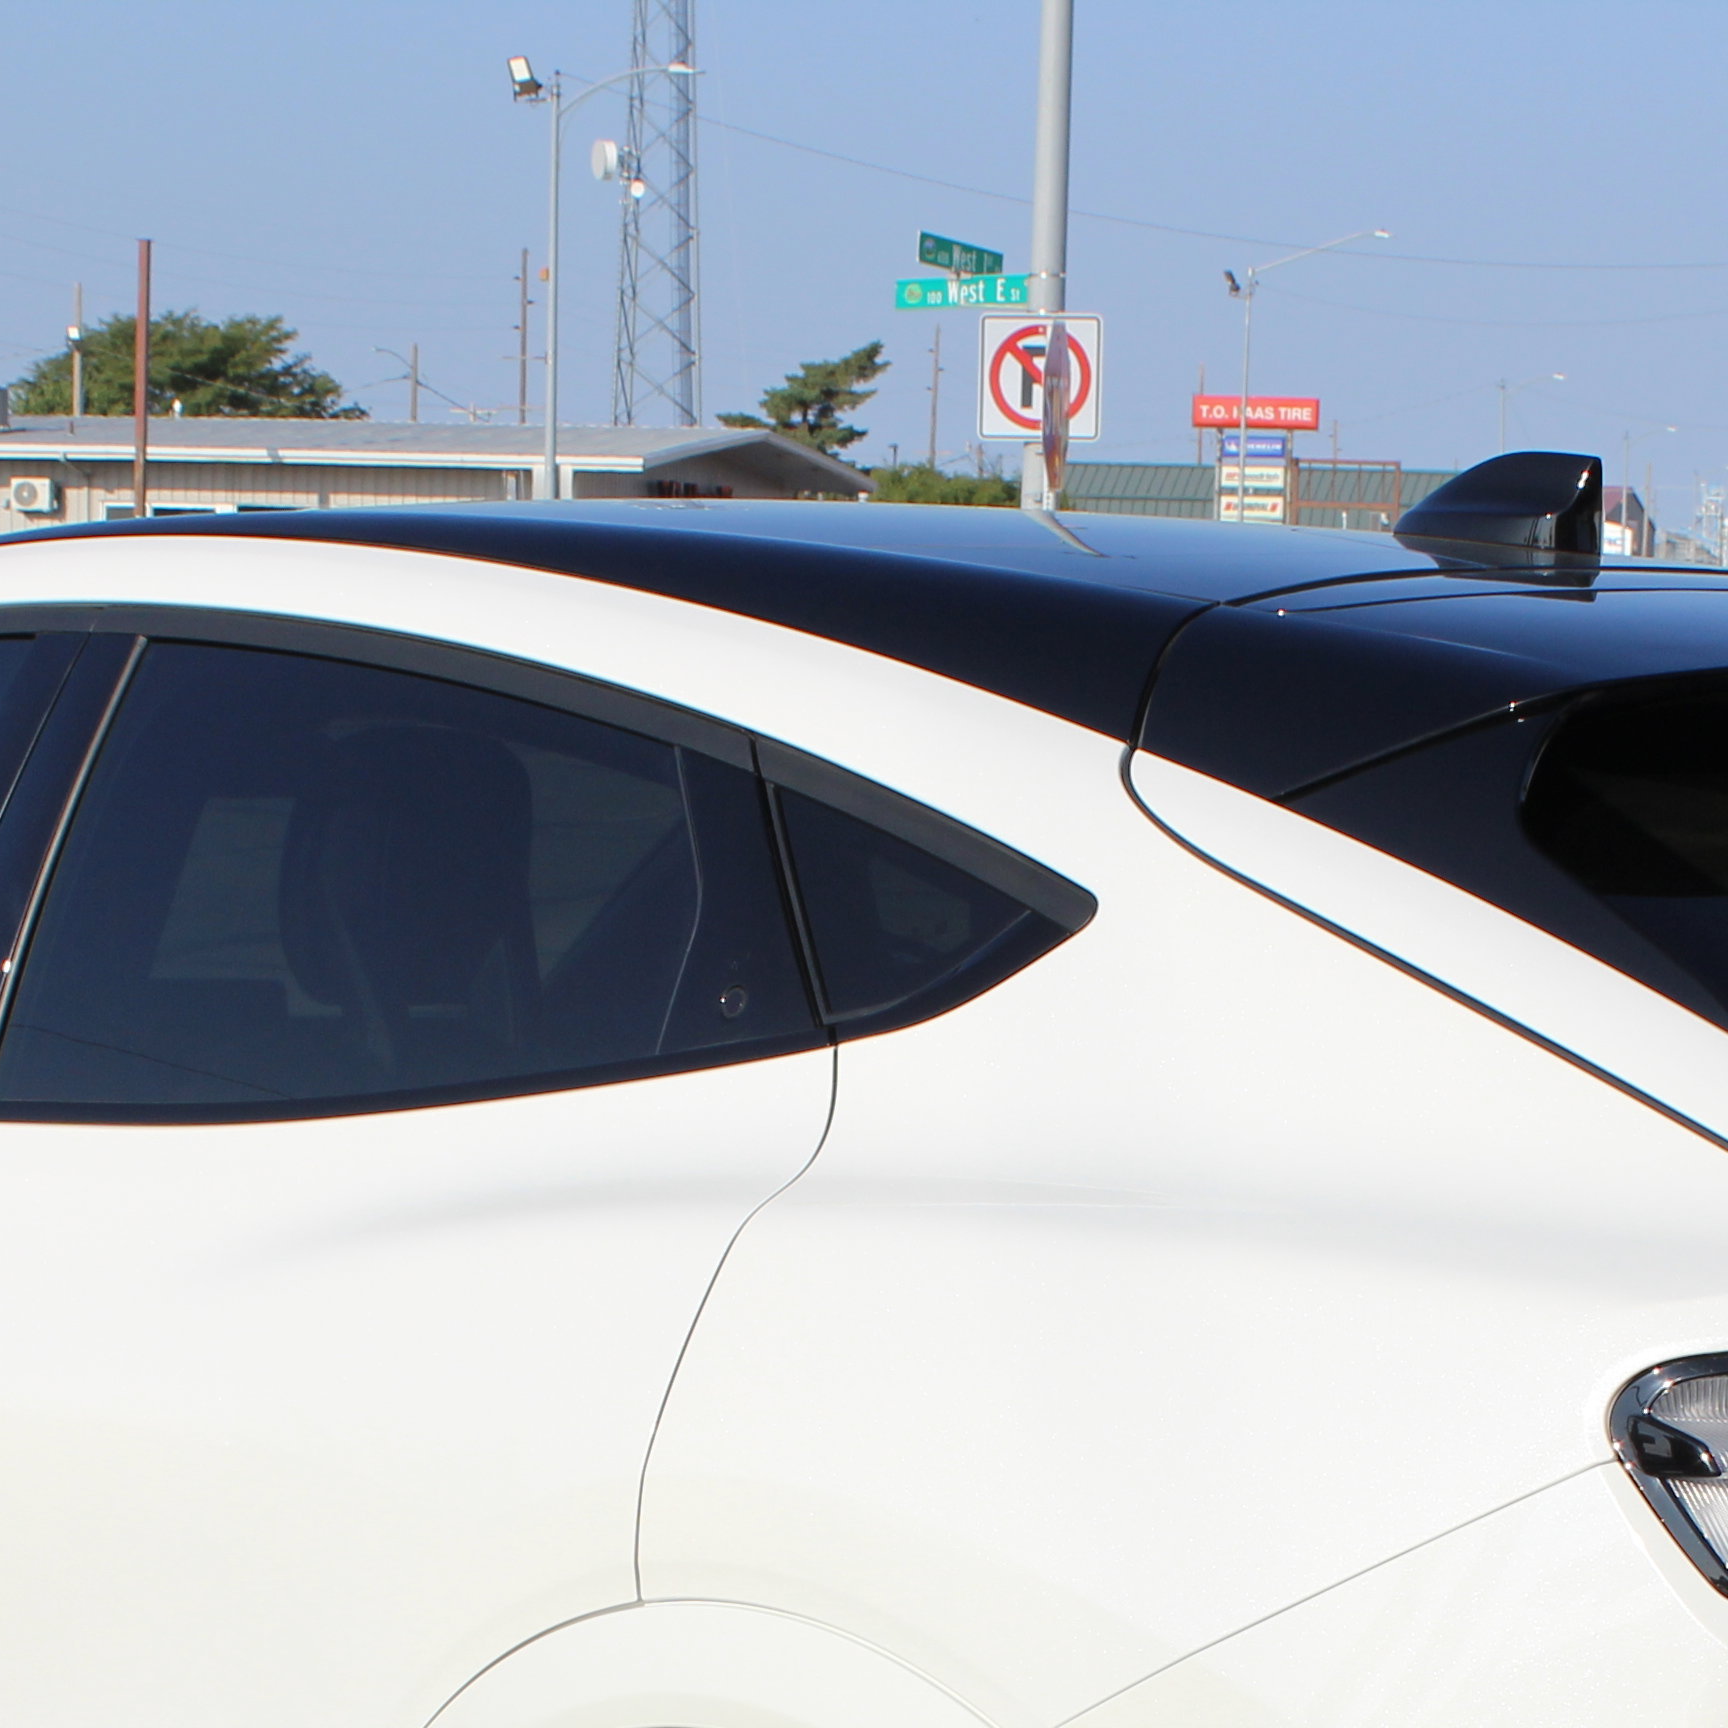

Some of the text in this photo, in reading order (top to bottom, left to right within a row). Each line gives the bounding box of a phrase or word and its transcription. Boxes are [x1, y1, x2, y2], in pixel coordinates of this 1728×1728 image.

[927, 291, 942, 304] 100
[947, 280, 985, 304] West
[996, 278, 1006, 302] E
[1200, 404, 1229, 419] T.O.
[1278, 407, 1312, 421] TIRE
